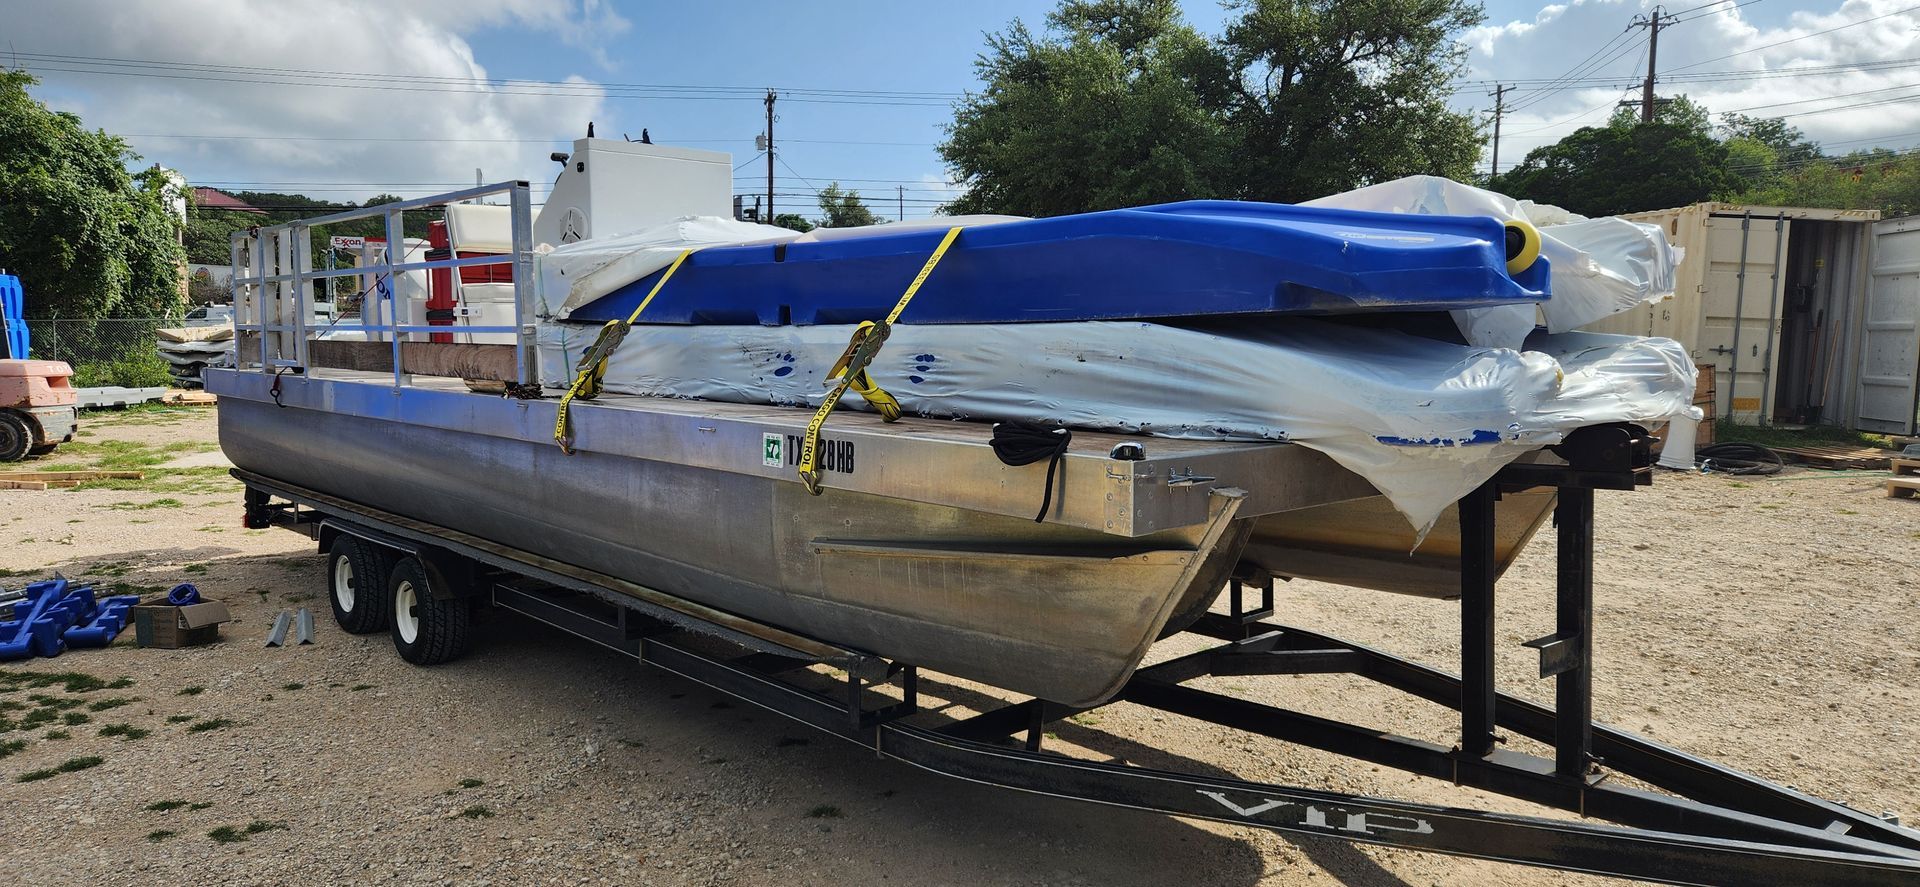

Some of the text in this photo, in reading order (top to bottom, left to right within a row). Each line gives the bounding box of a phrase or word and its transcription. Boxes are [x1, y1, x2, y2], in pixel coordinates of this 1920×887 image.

[335, 238, 361, 248] Exxon
[802, 387, 842, 467] CARGO CONTROL
